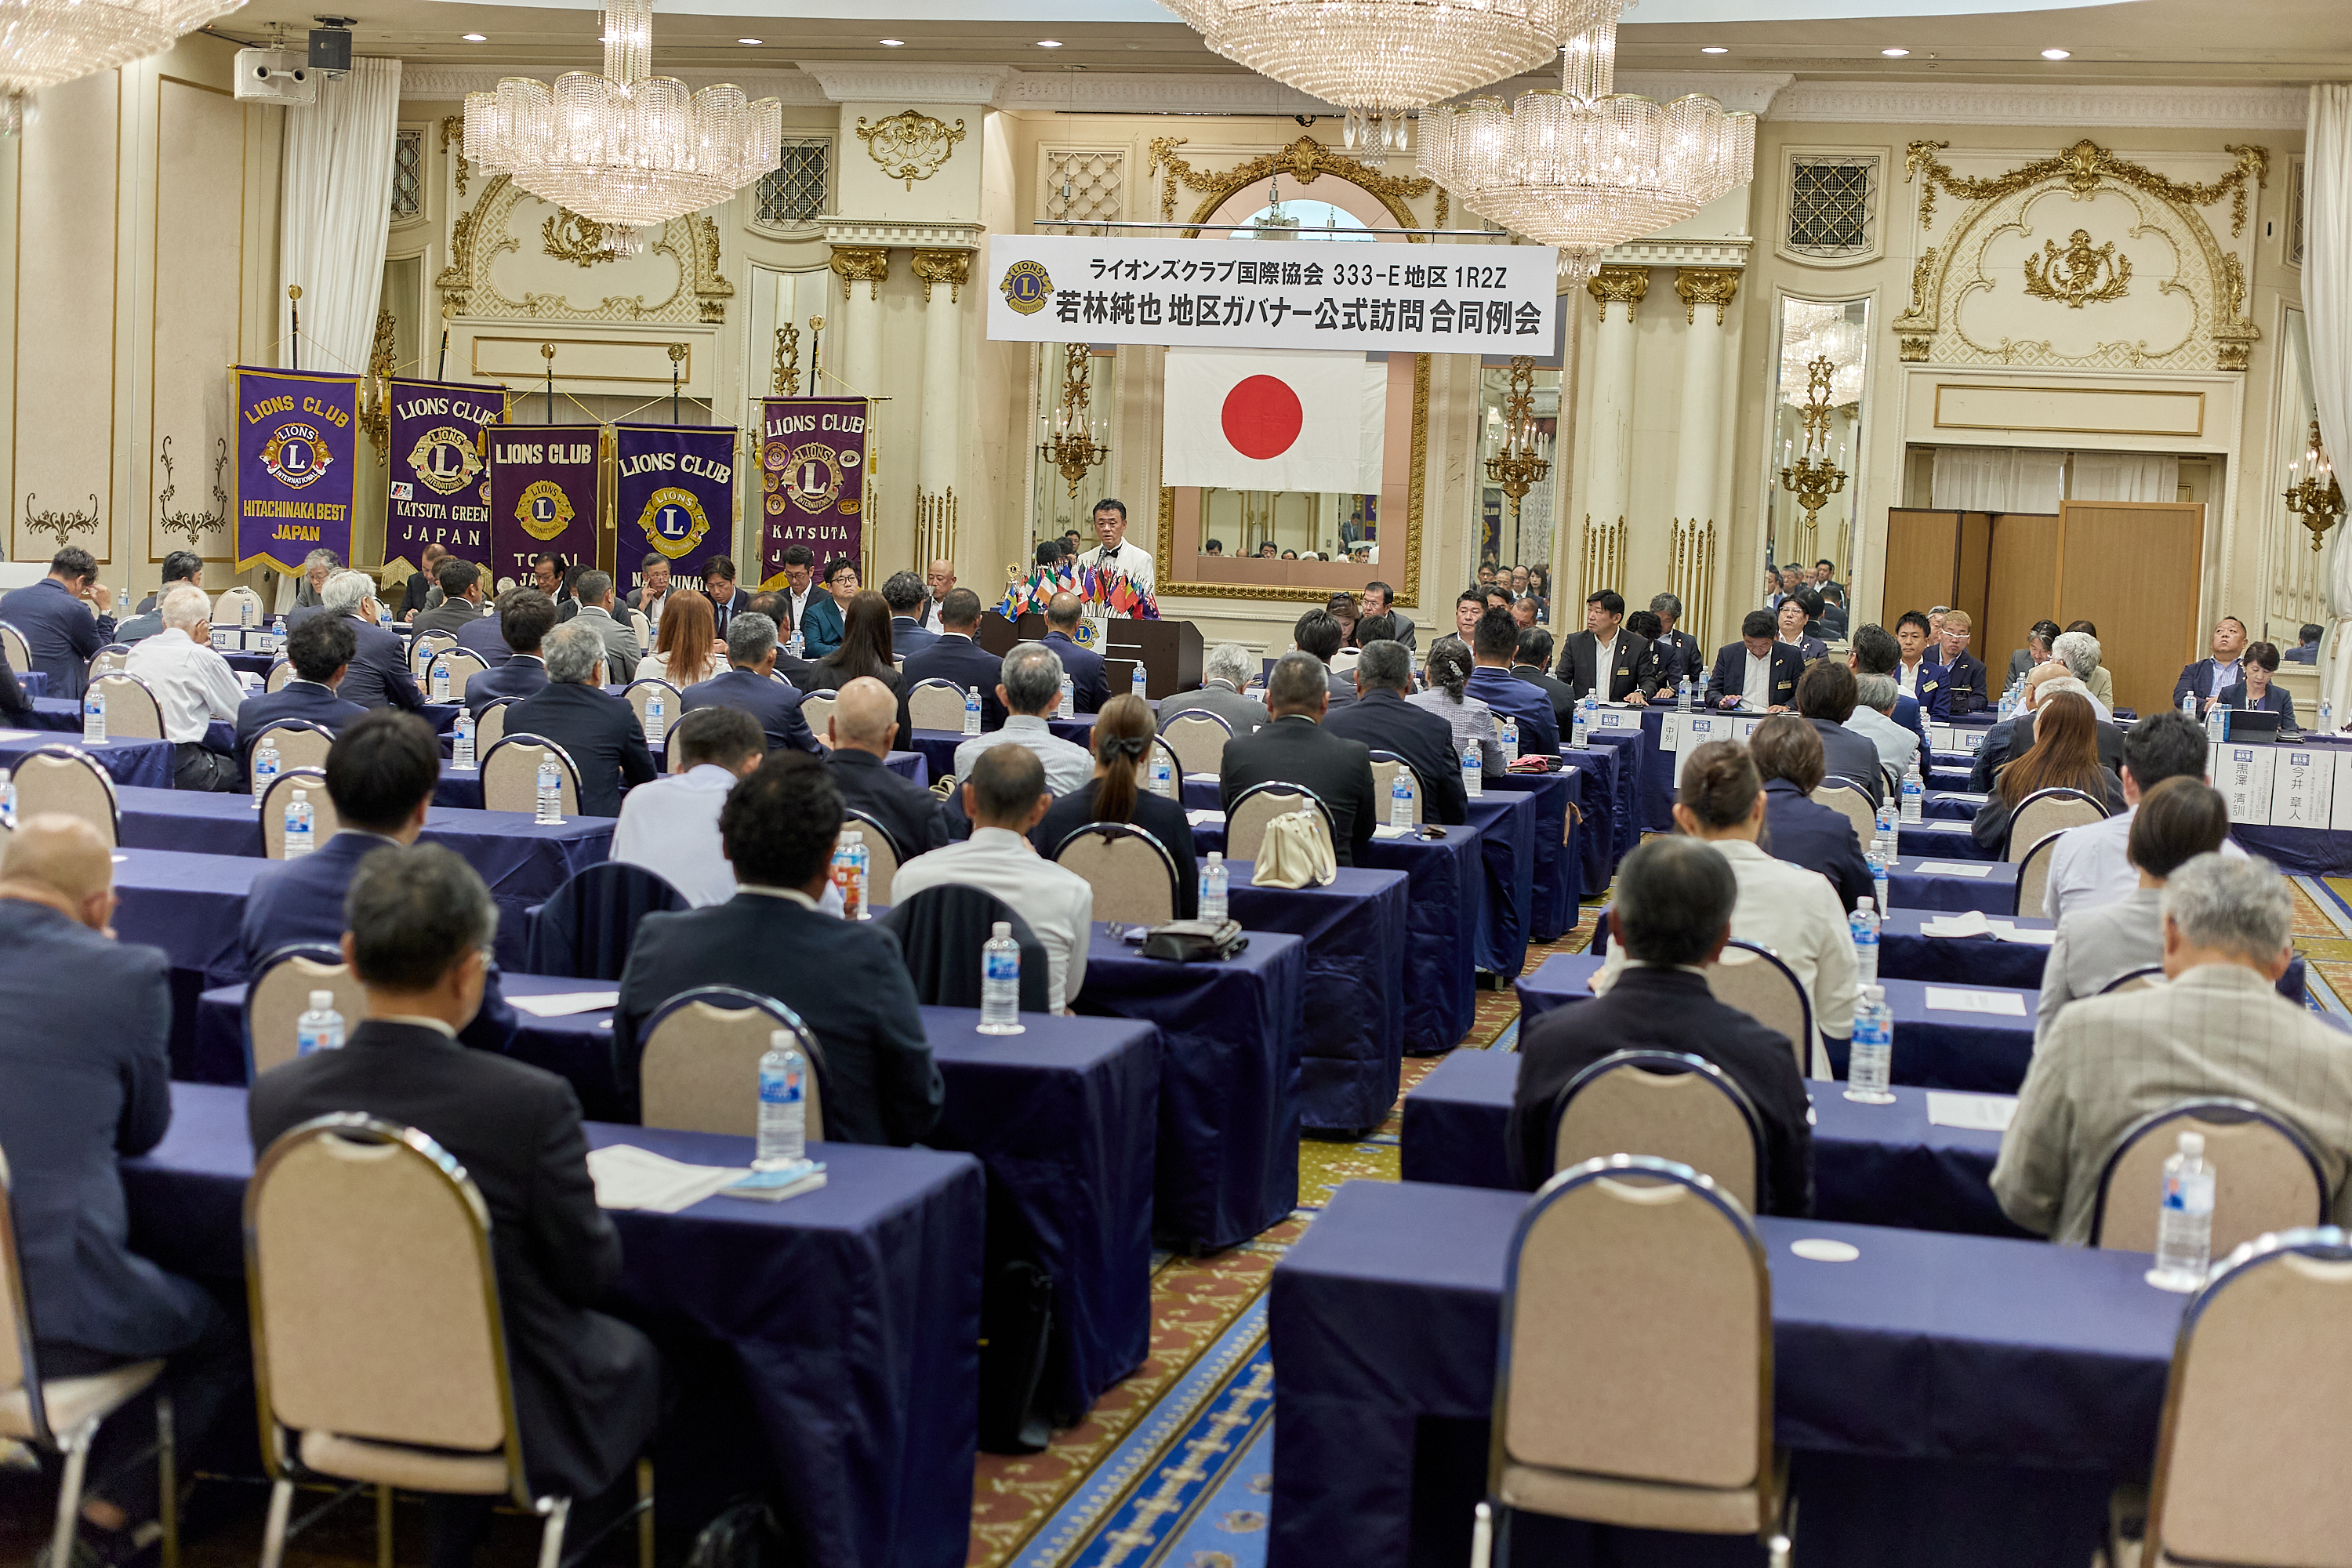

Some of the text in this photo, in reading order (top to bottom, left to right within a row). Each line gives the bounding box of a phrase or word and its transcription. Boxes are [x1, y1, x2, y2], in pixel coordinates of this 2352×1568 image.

[1012, 263, 1044, 274] LIONS
[1089, 260, 1323, 285] ライオンズクラブ国際協会
[1456, 267, 1506, 288] 1R2Z
[1021, 278, 1035, 296] L
[1011, 301, 1042, 312] INTERNATIONAL
[245, 395, 349, 428] LIONS CLUB
[396, 397, 449, 421] LIONS
[278, 426, 315, 440] LIONS
[766, 413, 865, 437] LIONS CLUB
[431, 430, 464, 445] LIONS
[287, 445, 305, 469] L
[434, 445, 459, 477] L
[496, 444, 592, 464] LIONS CLUB
[800, 446, 832, 461] LIONS
[619, 452, 731, 484] LIONS CLUB
[276, 470, 318, 485] INTERNATIONAL
[425, 474, 464, 490] INTERNATIONAL
[803, 463, 827, 494] L
[531, 485, 558, 496] LIONS
[655, 491, 693, 506] LIONS
[243, 499, 347, 521] HITACHINAKA BEST
[536, 499, 552, 519] L
[797, 495, 832, 510] INTERNATIONAL
[397, 501, 489, 522] KATSUTA GREEN
[528, 522, 560, 535] INTERNATIONAL
[663, 508, 684, 535] L
[271, 524, 320, 541] JAPAN
[403, 524, 480, 546] JAPAN
[772, 524, 848, 540] KATSUTA
[654, 538, 694, 551] INTERNATIONAL
[513, 553, 578, 567] TOAI
[771, 549, 847, 564] JAN
[1079, 628, 1087, 641] L
[1665, 726, 1674, 743] 中列
[2232, 763, 2249, 816] 黒澤 清訓
[2288, 766, 2304, 821] 今井 章人
